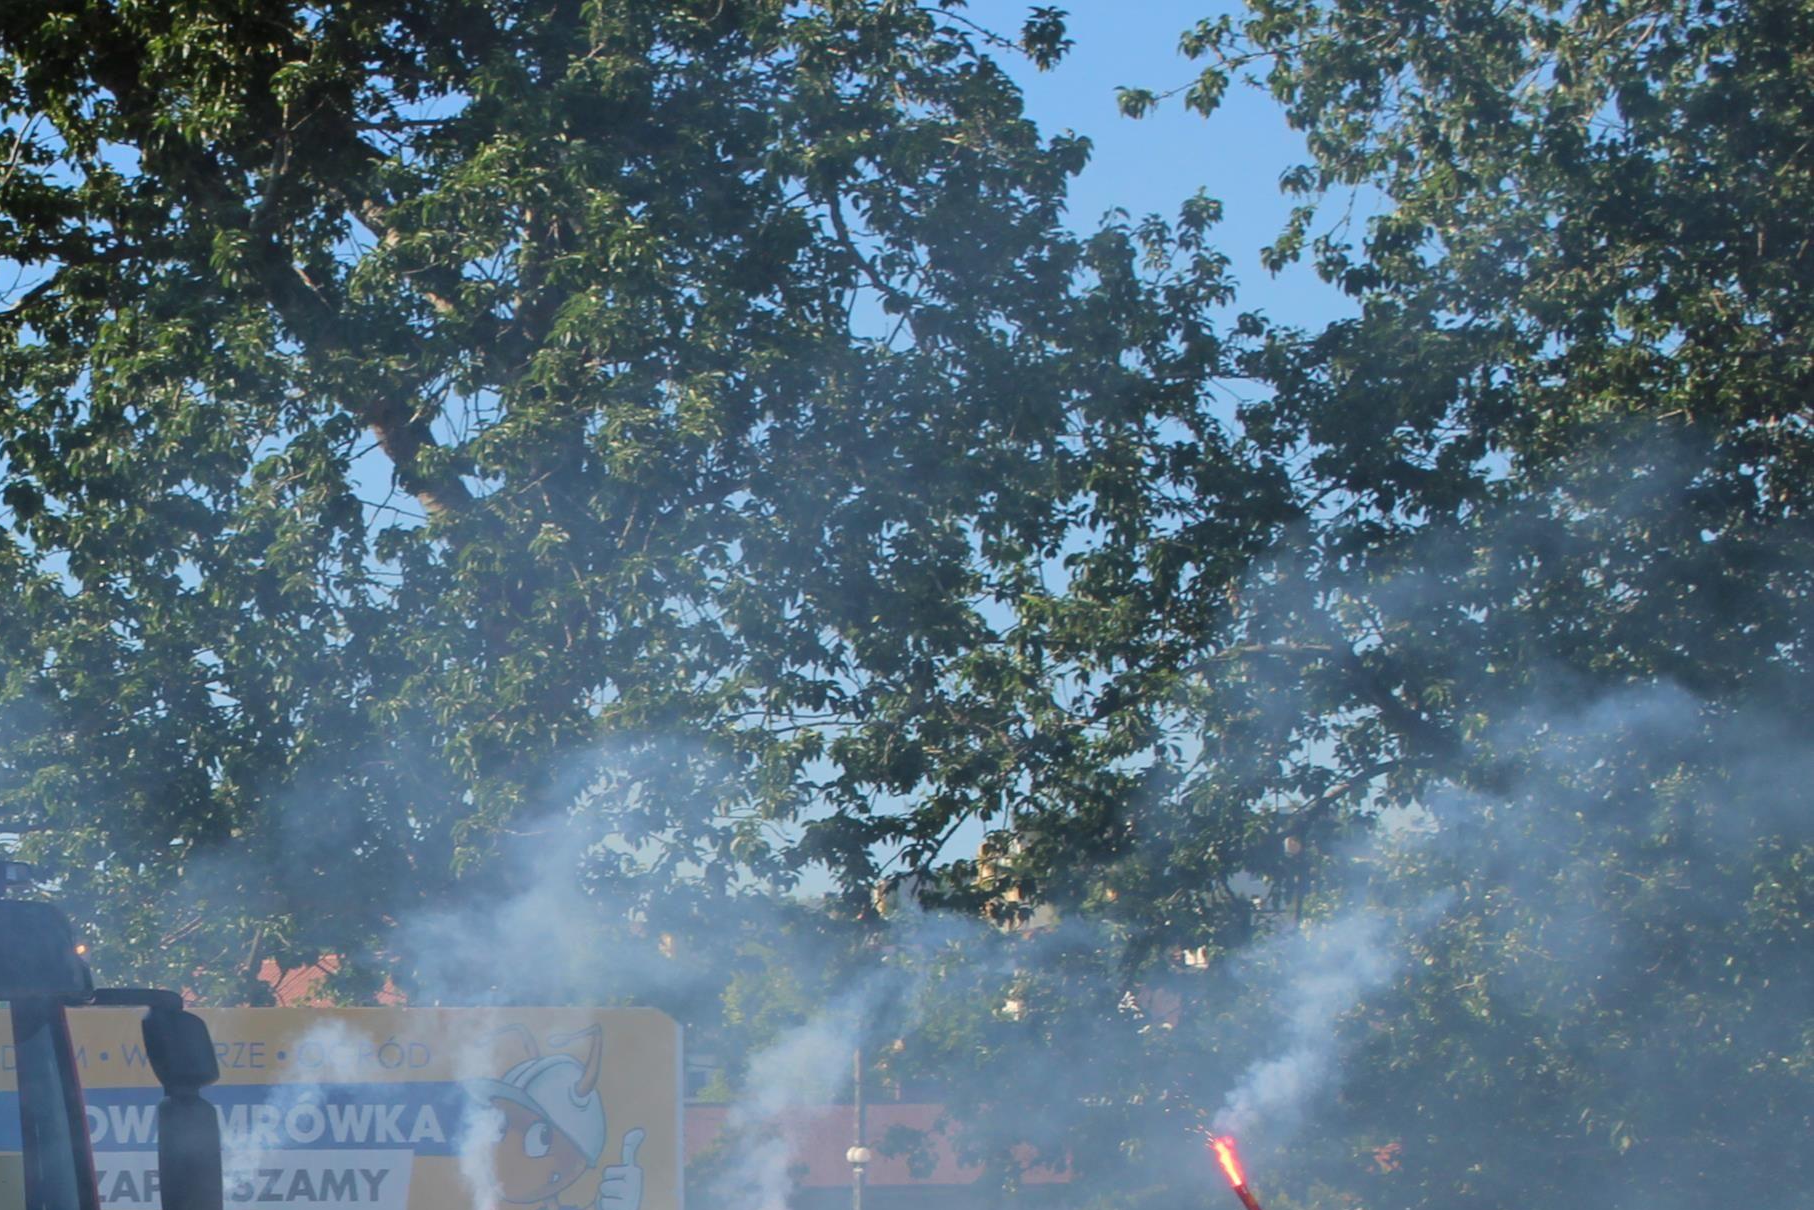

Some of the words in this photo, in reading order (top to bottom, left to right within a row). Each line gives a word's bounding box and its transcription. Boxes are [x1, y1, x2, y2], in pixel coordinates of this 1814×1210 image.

[121, 1041, 266, 1069] WRZE
[297, 1035, 431, 1070] ORÓD
[95, 1167, 390, 1204] APSZAMY
